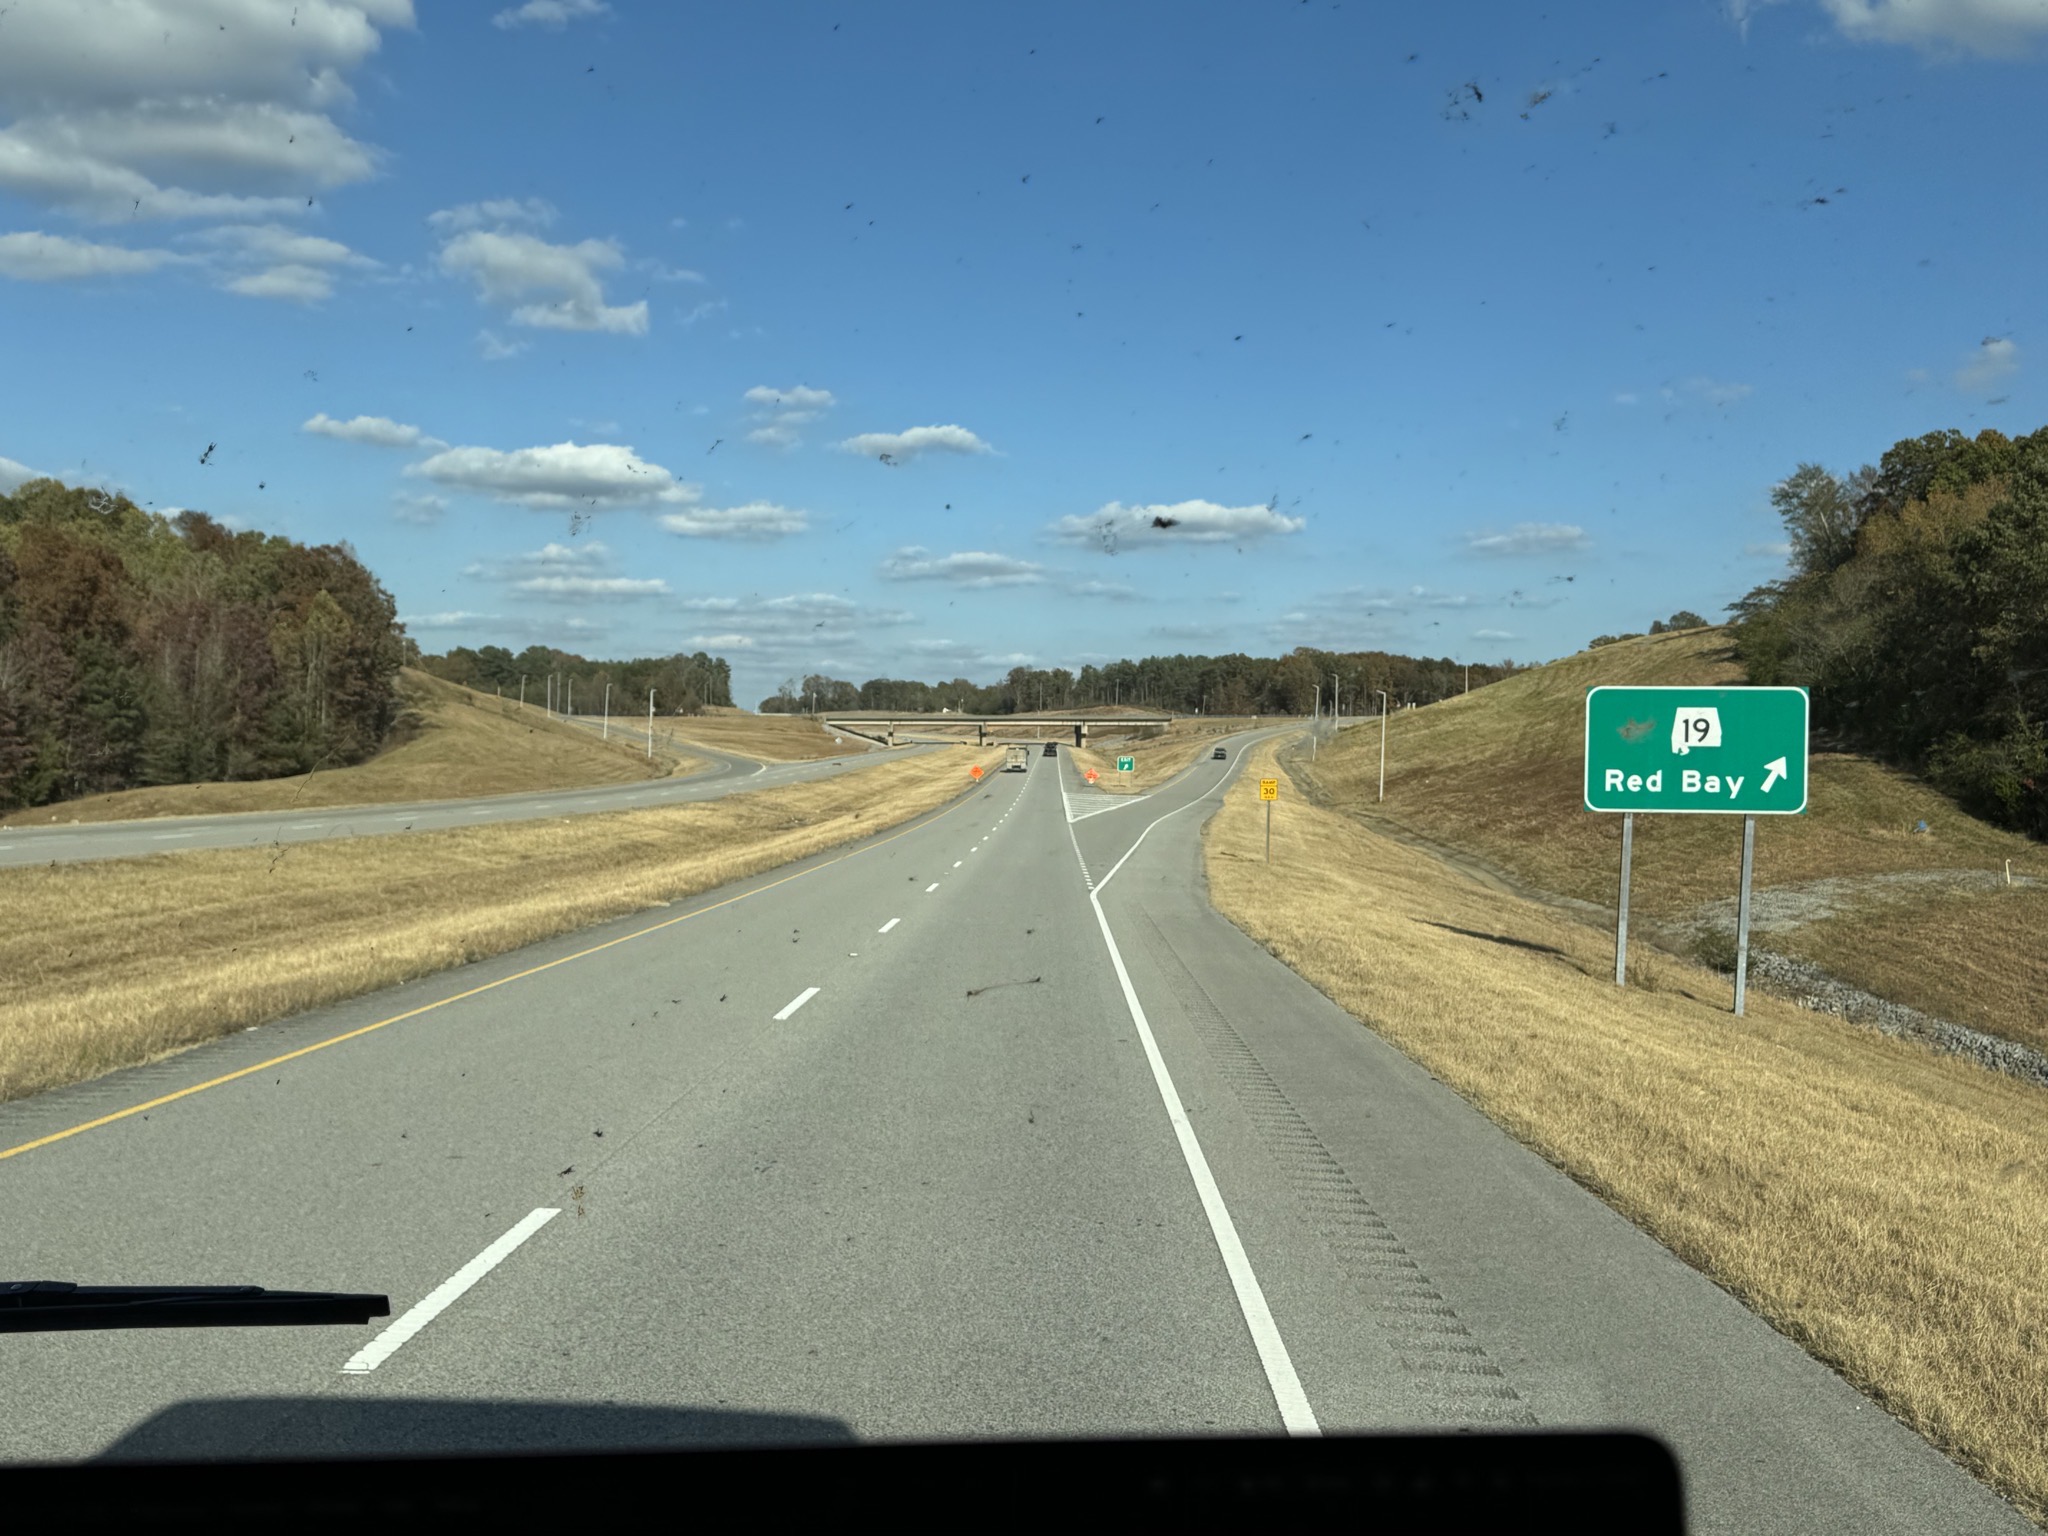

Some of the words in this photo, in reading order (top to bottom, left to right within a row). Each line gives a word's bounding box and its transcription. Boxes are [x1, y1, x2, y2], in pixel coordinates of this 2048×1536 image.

[1682, 718, 1710, 743] 19
[1263, 787, 1275, 795] 30
[1604, 769, 1663, 792] Red
[1681, 769, 1745, 799] Bay
